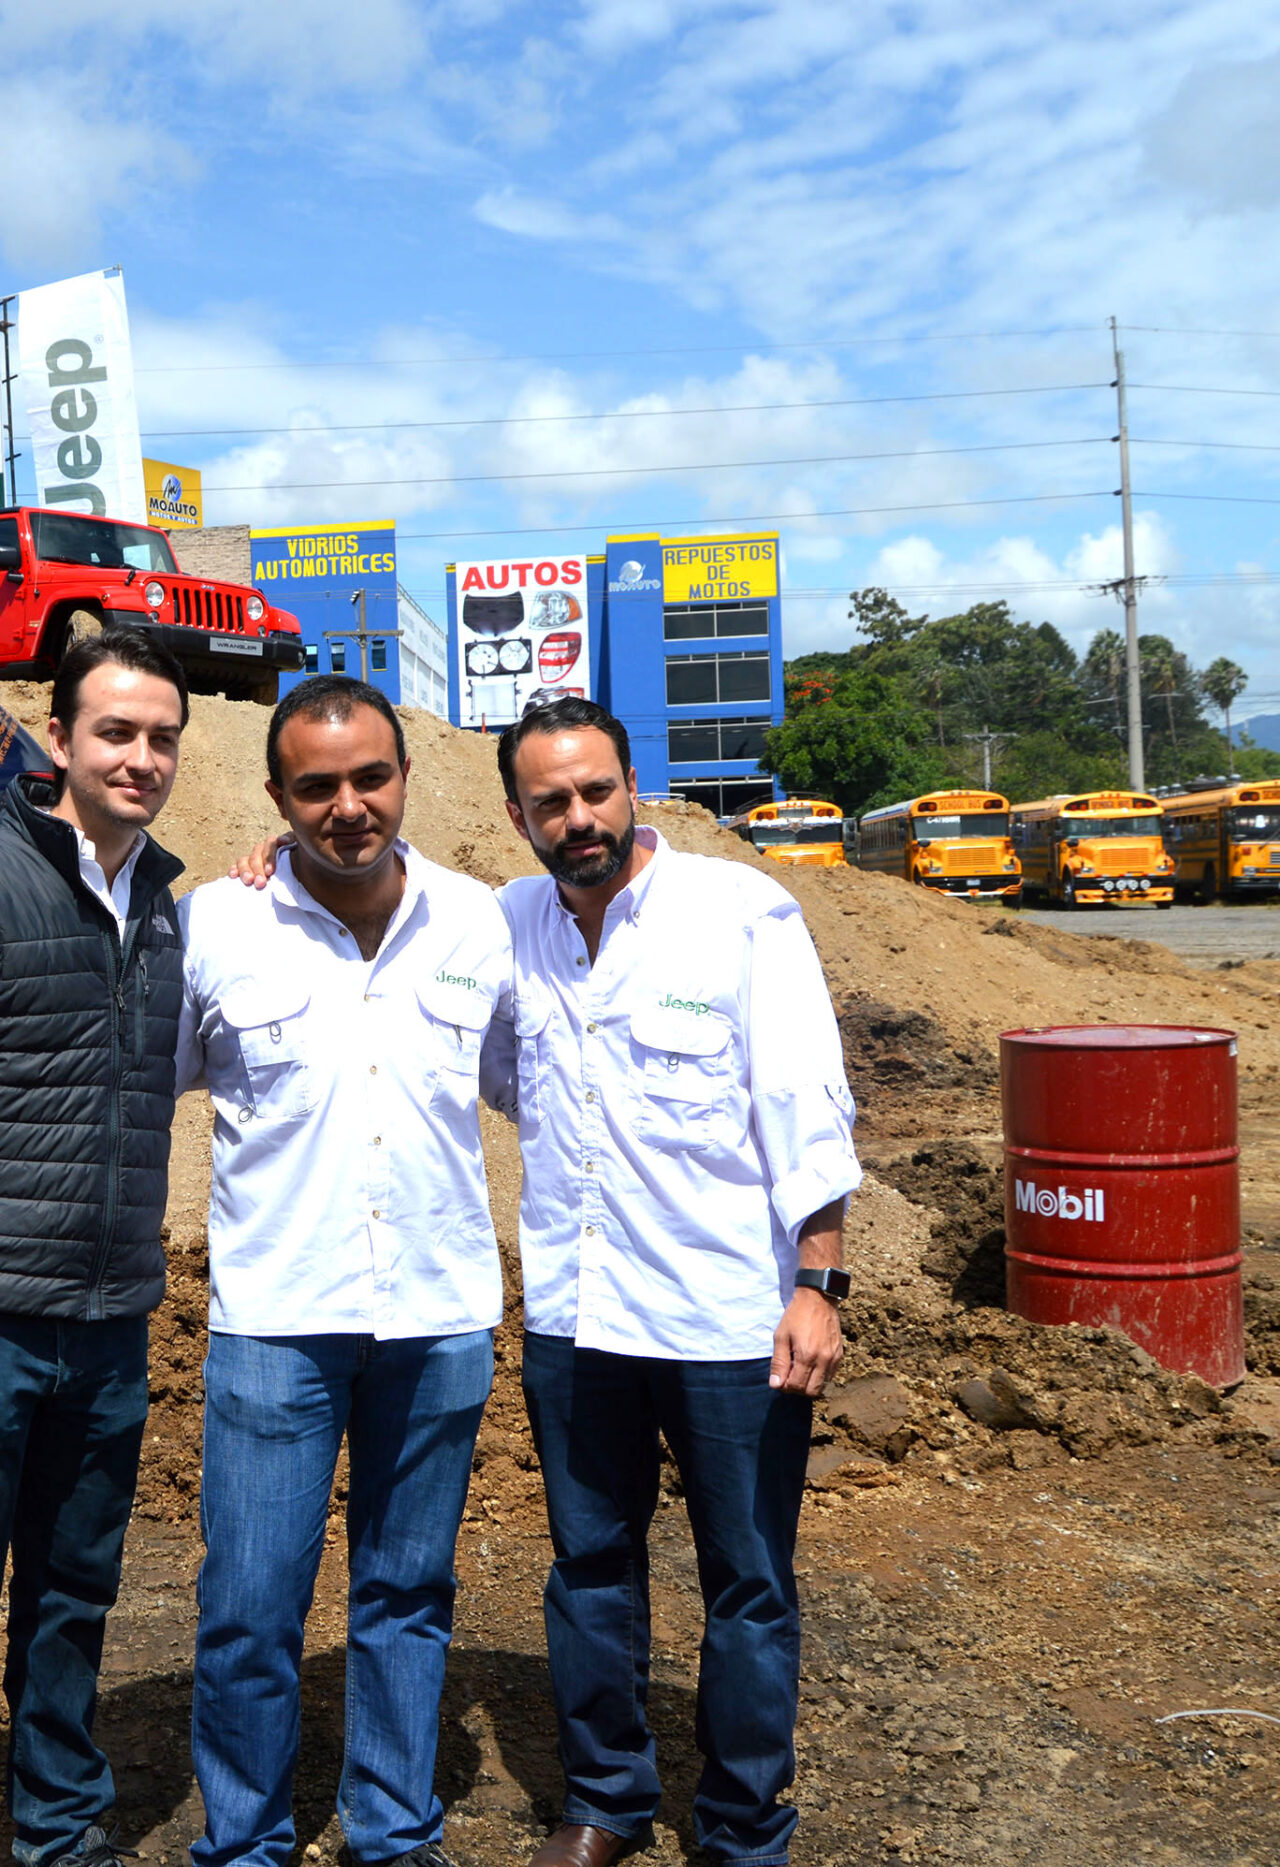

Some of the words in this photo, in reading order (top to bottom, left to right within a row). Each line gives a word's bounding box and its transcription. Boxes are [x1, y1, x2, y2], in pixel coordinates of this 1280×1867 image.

[43, 338, 108, 518] Jeep
[149, 497, 198, 517] MOAUTO
[286, 534, 359, 557] VIDRIOS
[664, 544, 773, 566] REPUESTOS
[254, 552, 395, 581] AUTOMOTRICES
[461, 559, 583, 592] AUTOS
[707, 564, 731, 581] DE
[608, 578, 662, 593] MOAUTO
[688, 581, 751, 599] MOTOS
[216, 641, 258, 651] WRANGLER
[436, 970, 478, 990] Jeep
[658, 994, 710, 1016] Jeep
[1015, 1178, 1105, 1223] Mobil
